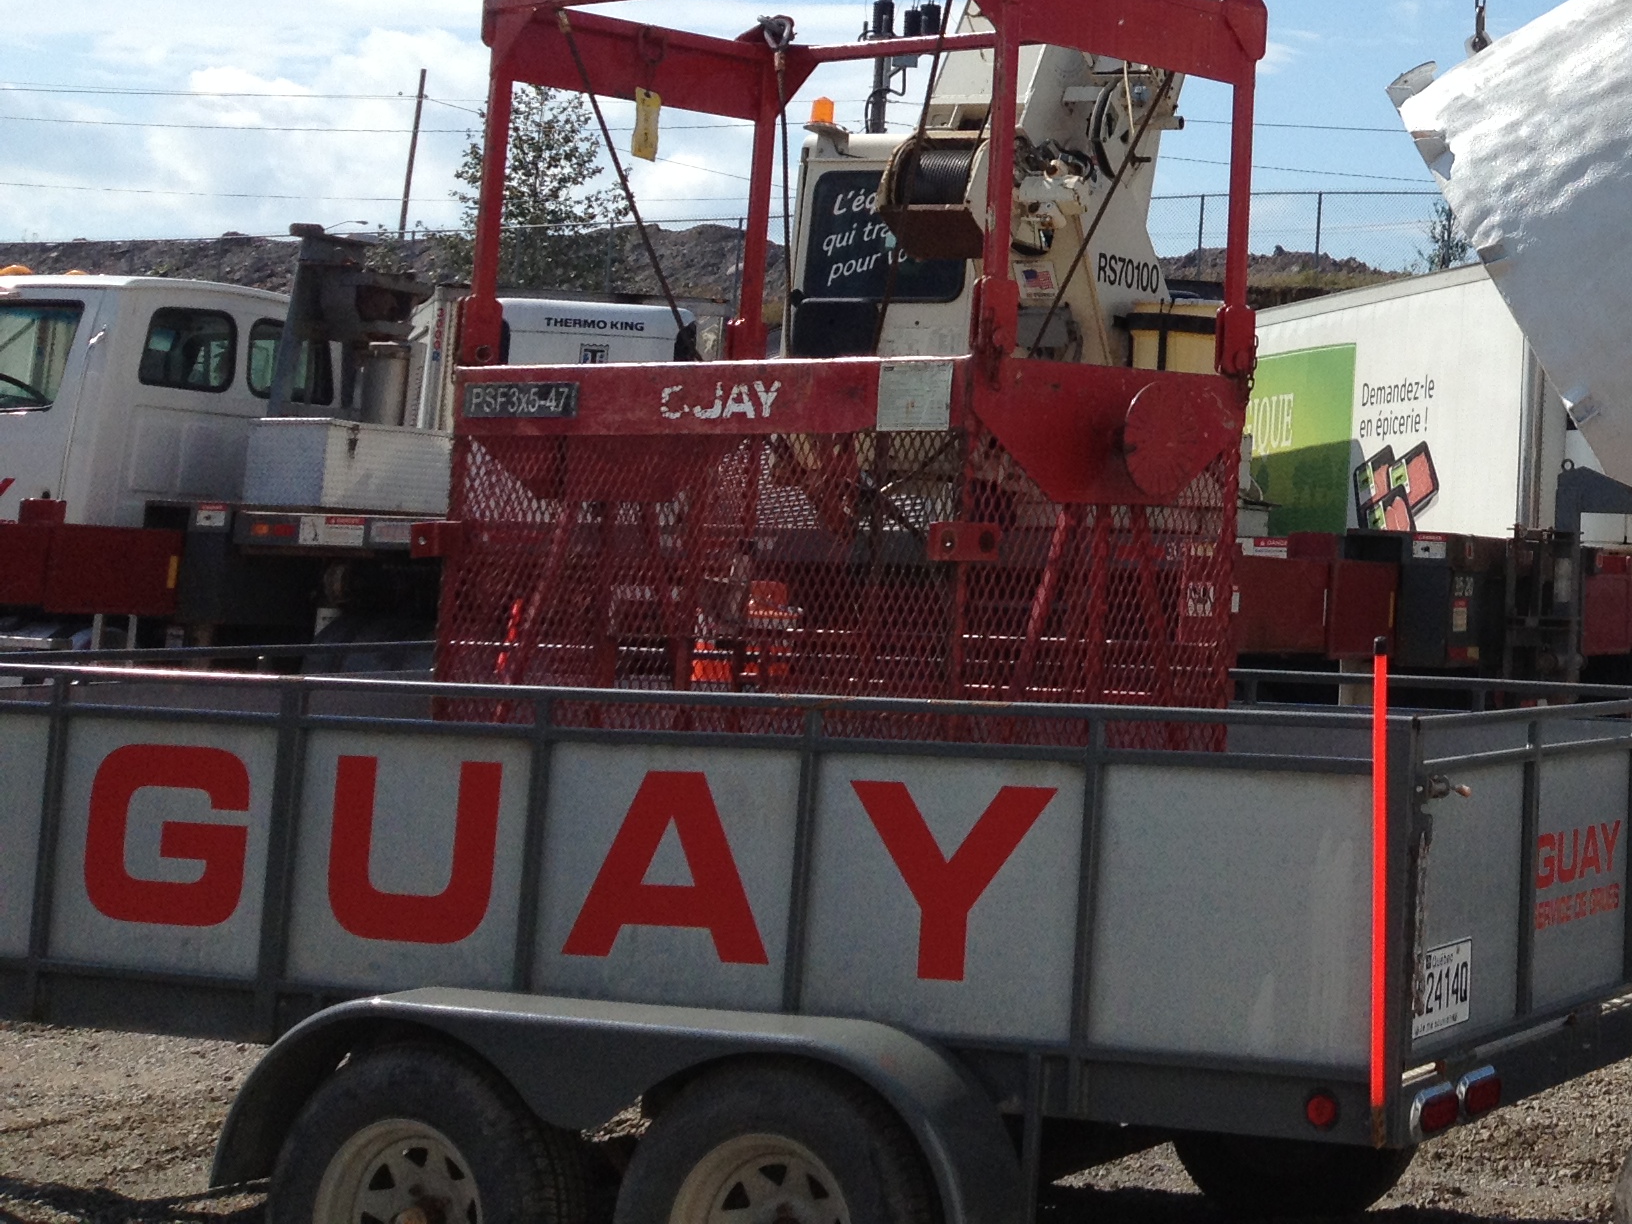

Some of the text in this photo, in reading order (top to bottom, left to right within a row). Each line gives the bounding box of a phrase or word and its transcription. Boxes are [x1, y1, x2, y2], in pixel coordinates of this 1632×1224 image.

[833, 188, 879, 215] L'éq
[822, 221, 891, 257] qui tra
[827, 252, 882, 287] pour
[1097, 252, 1160, 294] RS70100
[544, 317, 645, 332] THERMO KING
[471, 386, 570, 414] PSF3x5-47
[1361, 374, 1435, 407] Demandez-le
[1359, 417, 1374, 439] en
[1376, 410, 1422, 441] épicerie
[83, 742, 1059, 982] GUAY
[1535, 819, 1622, 890] GUAY
[1425, 961, 1469, 1015] 2414Q
